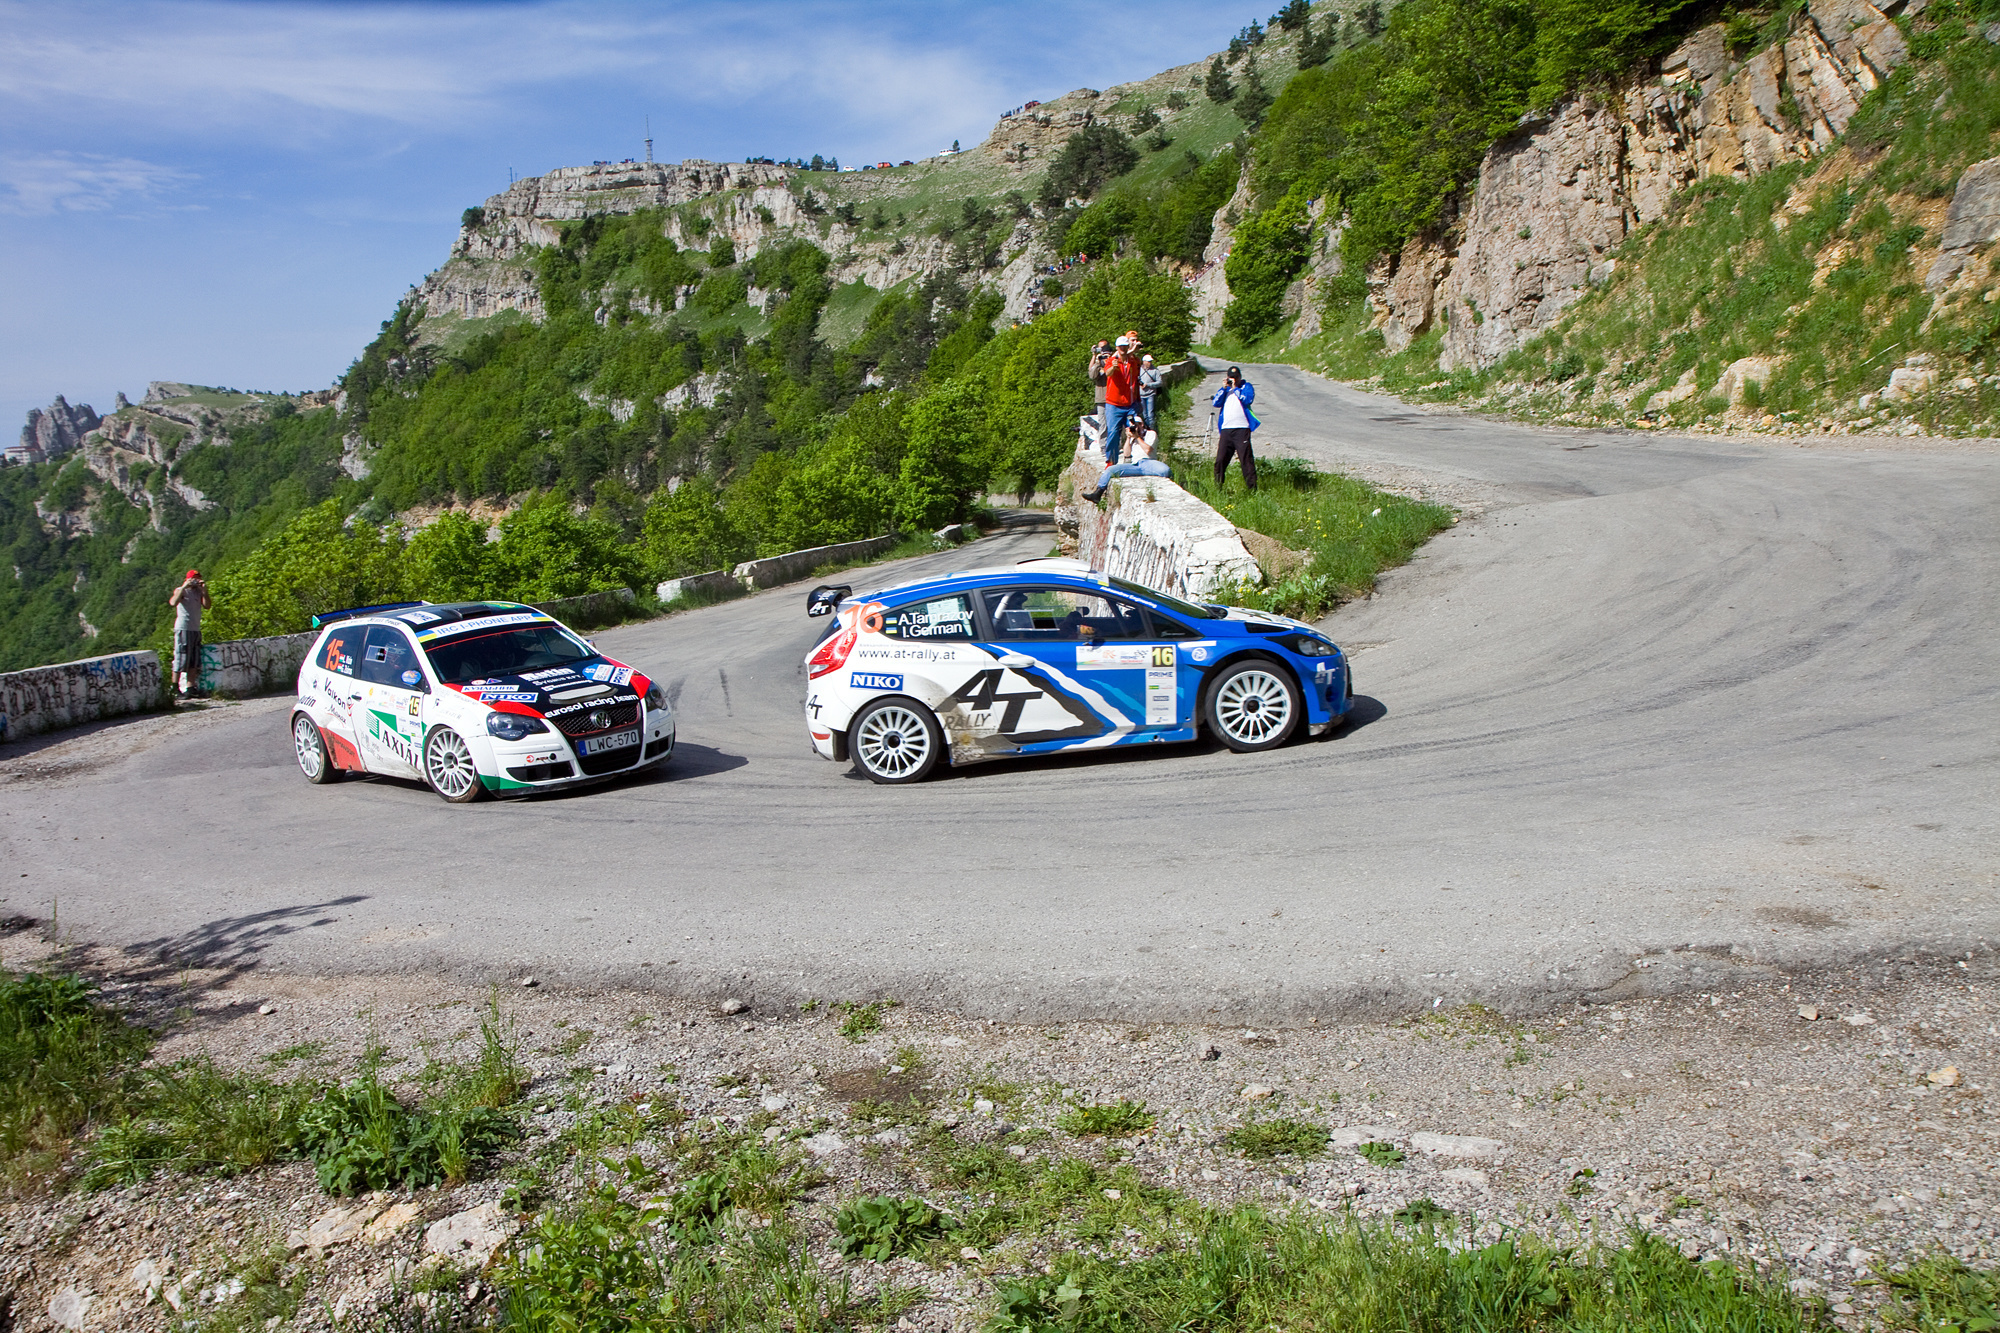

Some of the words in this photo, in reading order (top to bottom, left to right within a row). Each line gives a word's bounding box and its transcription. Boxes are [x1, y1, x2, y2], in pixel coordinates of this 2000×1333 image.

[436, 624, 459, 636] IRC
[460, 616, 508, 631] I-PHONE
[510, 614, 532, 624] APP
[844, 602, 883, 633] 16
[325, 638, 344, 671] 15
[859, 649, 956, 662] www.at-rally.at
[1152, 647, 1174, 666] 16
[851, 674, 900, 688] NIKO
[410, 696, 420, 716] 15
[484, 693, 534, 702] NIKO
[544, 702, 584, 718] eurosol
[584, 695, 616, 708] racing
[613, 694, 639, 703] team
[944, 712, 992, 730] RALLY
[588, 731, 637, 752] LWC-570
